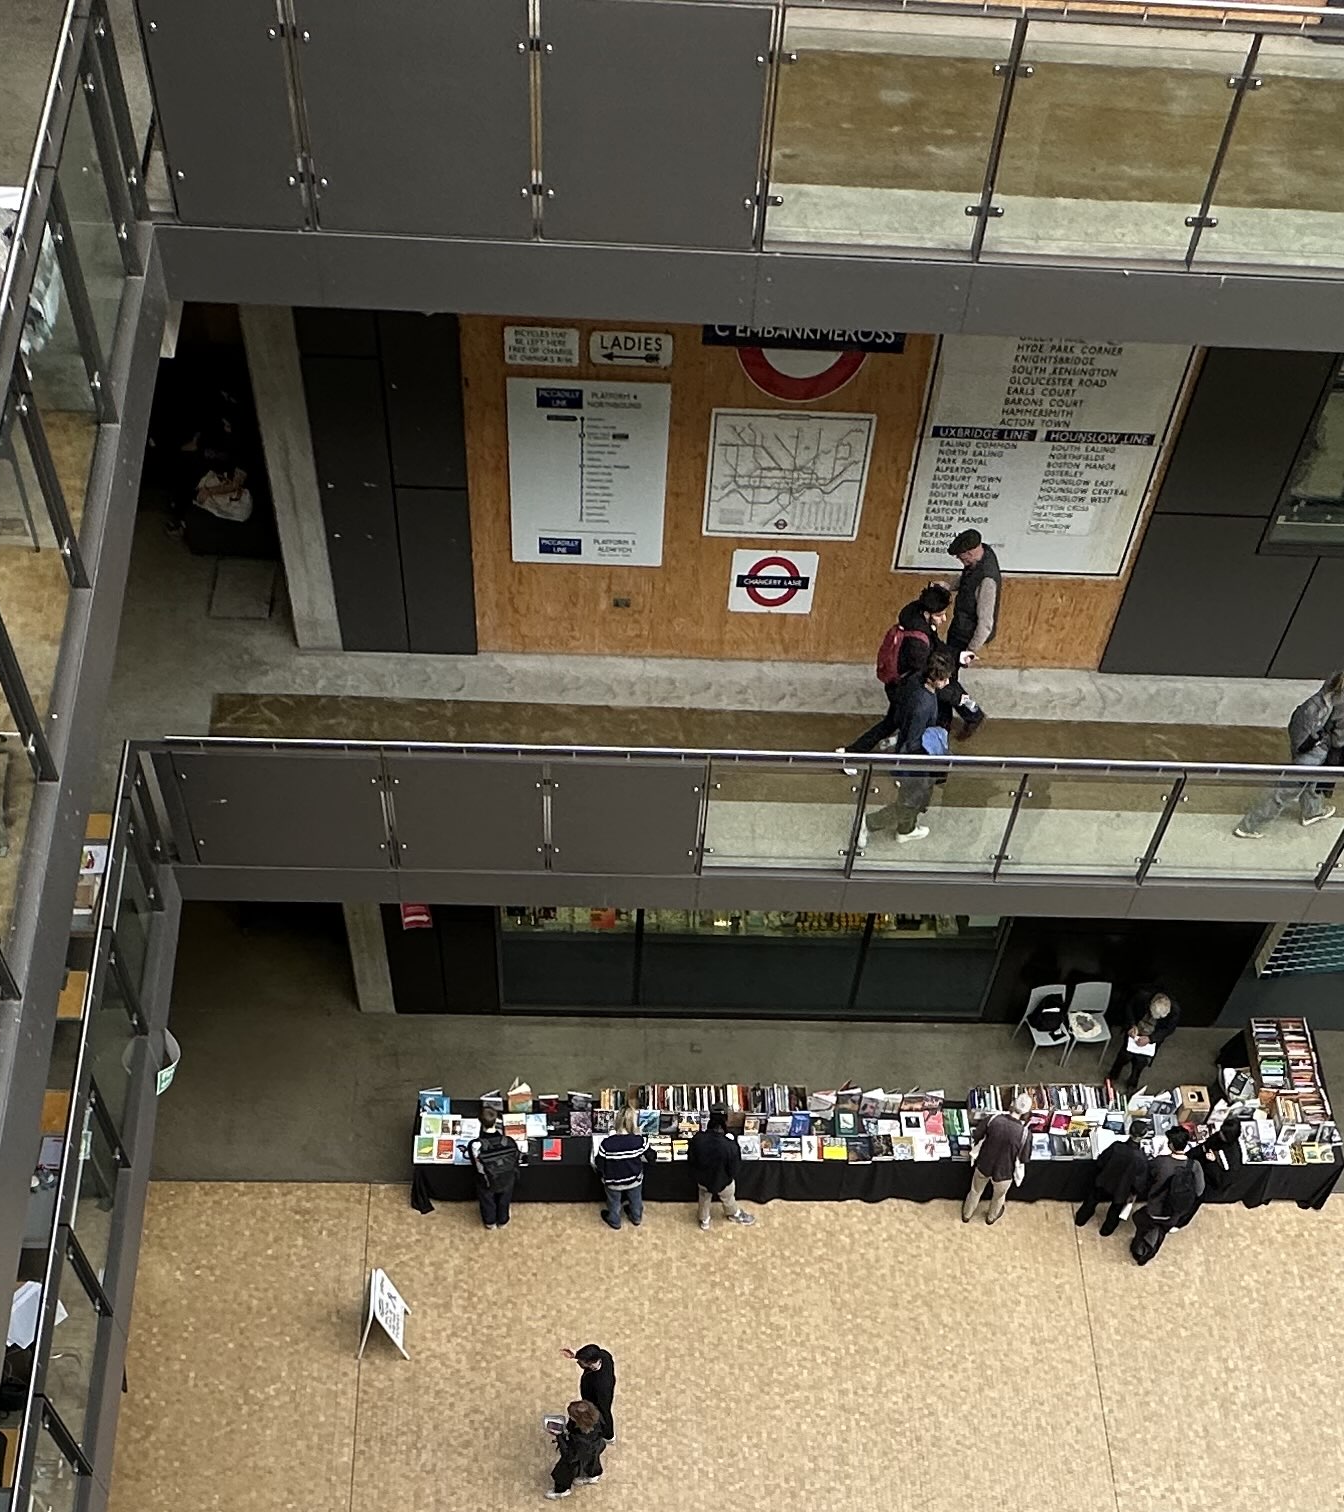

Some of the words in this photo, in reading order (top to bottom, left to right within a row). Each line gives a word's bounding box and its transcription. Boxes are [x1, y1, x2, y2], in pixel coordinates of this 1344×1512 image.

[600, 335, 663, 352] LADIES
[1016, 344, 1044, 353] HYDE
[1049, 344, 1075, 354] PARK
[1080, 346, 1123, 356] CORNER
[1014, 355, 1096, 366] KNIGHTSBRIDGE
[1011, 365, 1047, 376] SOUTH
[1049, 367, 1118, 377] KENSINGTON
[1008, 376, 1074, 387] GLOUCESTER
[1077, 378, 1108, 388] ROAD
[538, 390, 581, 399] PICCADILLY
[591, 391, 630, 400] PLATFORM
[1006, 386, 1035, 396] EARLS
[1040, 388, 1077, 397] COURT
[551, 399, 568, 407] LINE
[587, 401, 642, 409] NORTHBOUND
[1004, 397, 1044, 407] BARONS
[1048, 399, 1084, 408] COURT
[1001, 408, 1074, 418] HAMMERSMITH
[999, 418, 1035, 427] ACTON
[1041, 419, 1071, 428] TOWN
[939, 428, 999, 440] UXBRIDGE
[1003, 430, 1032, 440] LINE
[1050, 431, 1120, 444] HOUNSLOW
[1120, 434, 1152, 445] LINE
[940, 440, 971, 448] EALING
[975, 441, 1018, 450] COMMON
[1051, 444, 1081, 452] SOUTH
[1085, 446, 1116, 454] EALING
[937, 448, 969, 456] NORTH
[972, 450, 1004, 458] EALING
[1048, 453, 1105, 461] NORTHFIELDS
[936, 457, 957, 465] PARK
[961, 458, 988, 466] ROYAL
[1046, 461, 1081, 469] BOSTON
[1084, 463, 1116, 471] MANOR
[934, 466, 978, 474] ALPERTON
[1044, 470, 1084, 478] OSTERLEY
[932, 474, 971, 483] SUDBURY
[976, 475, 1002, 483] TOWN
[1042, 478, 1090, 486] HOUNSLOW
[931, 482, 970, 490] SUDBURY
[973, 483, 991, 491] HILL
[1040, 486, 1089, 494] HOUNSLOW
[1091, 488, 1128, 496] CENTRAL
[929, 490, 959, 498] SOUTH
[962, 491, 1001, 500] HARROW
[1037, 494, 1086, 503] HOUNSLOW
[967, 500, 989, 508] LANE
[925, 507, 967, 515] EASTCOTE
[924, 514, 955, 523] RUISLIP
[957, 516, 989, 524] MANOR
[540, 539, 580, 547] PICCADILLY
[593, 538, 630, 546] PLATFORM
[552, 546, 567, 554] LINE
[743, 578, 781, 586] CHANCERY
[783, 579, 802, 587] LANE
